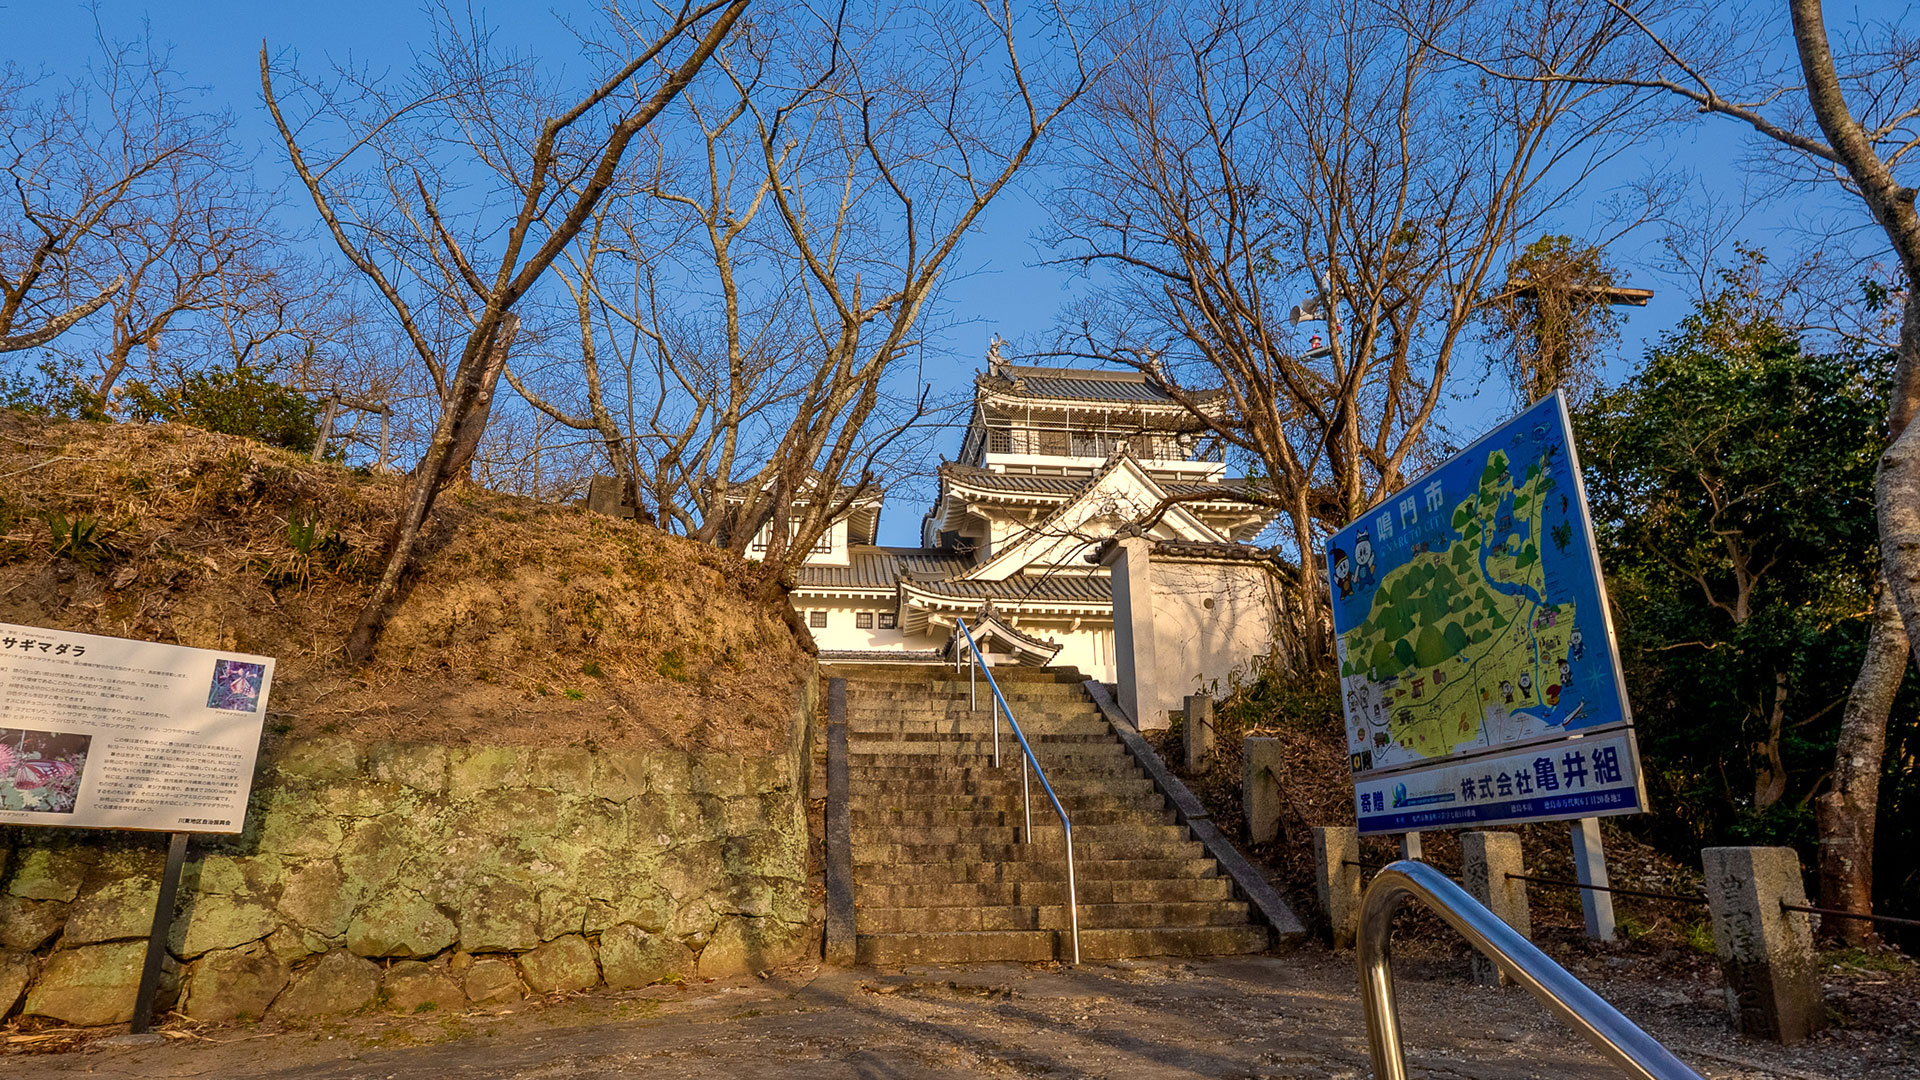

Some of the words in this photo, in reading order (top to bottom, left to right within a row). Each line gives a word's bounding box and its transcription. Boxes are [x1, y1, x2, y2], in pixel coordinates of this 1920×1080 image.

[1375, 478, 1444, 543] 鳴門市
[1424, 512, 1446, 532] CITY
[2, 636, 86, 657] サギマダラ
[1460, 745, 1623, 802] 株式会社亀井組
[1360, 790, 1384, 813] 寄贈
